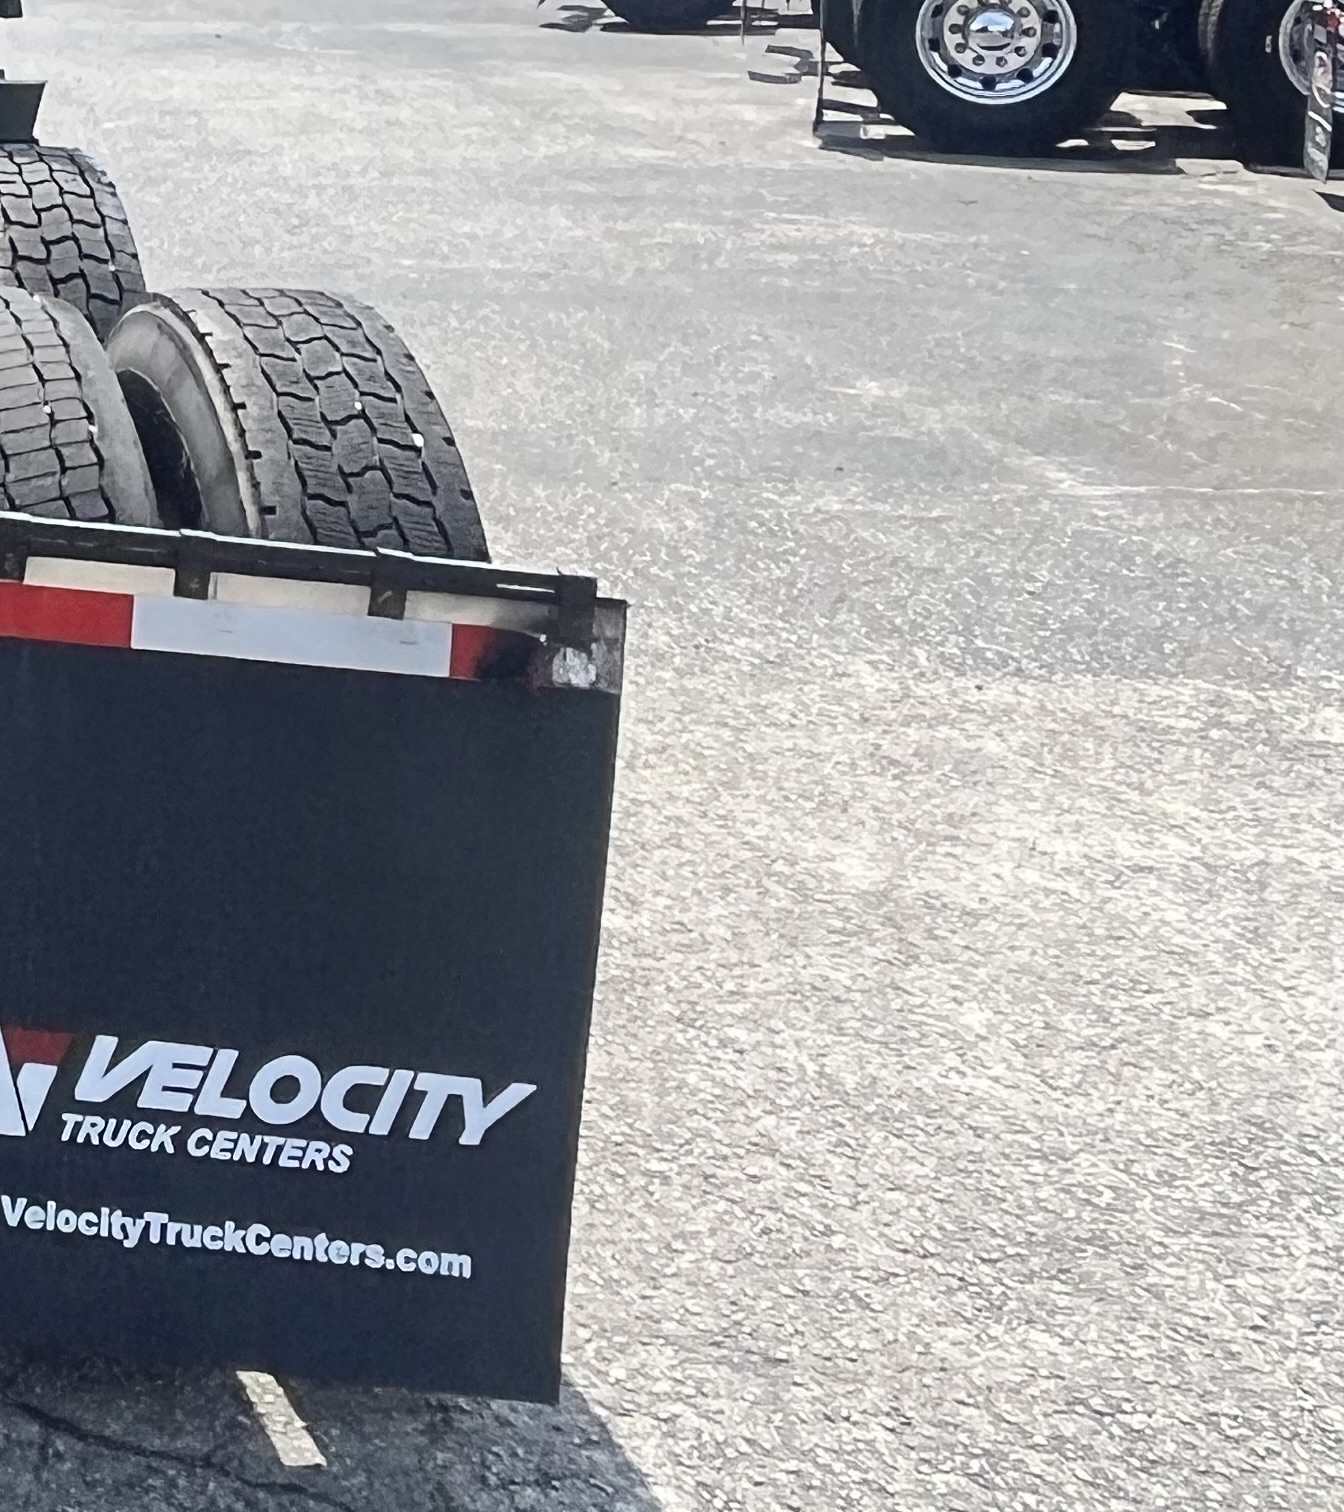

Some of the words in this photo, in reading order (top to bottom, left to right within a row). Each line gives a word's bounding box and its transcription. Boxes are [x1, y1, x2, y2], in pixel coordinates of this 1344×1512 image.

[74, 1034, 538, 1146] VELOCITY
[60, 1112, 182, 1154] TRUCK
[186, 1127, 354, 1174] CENTERS
[0, 1194, 472, 1279] VelocityTruckCenters.com
